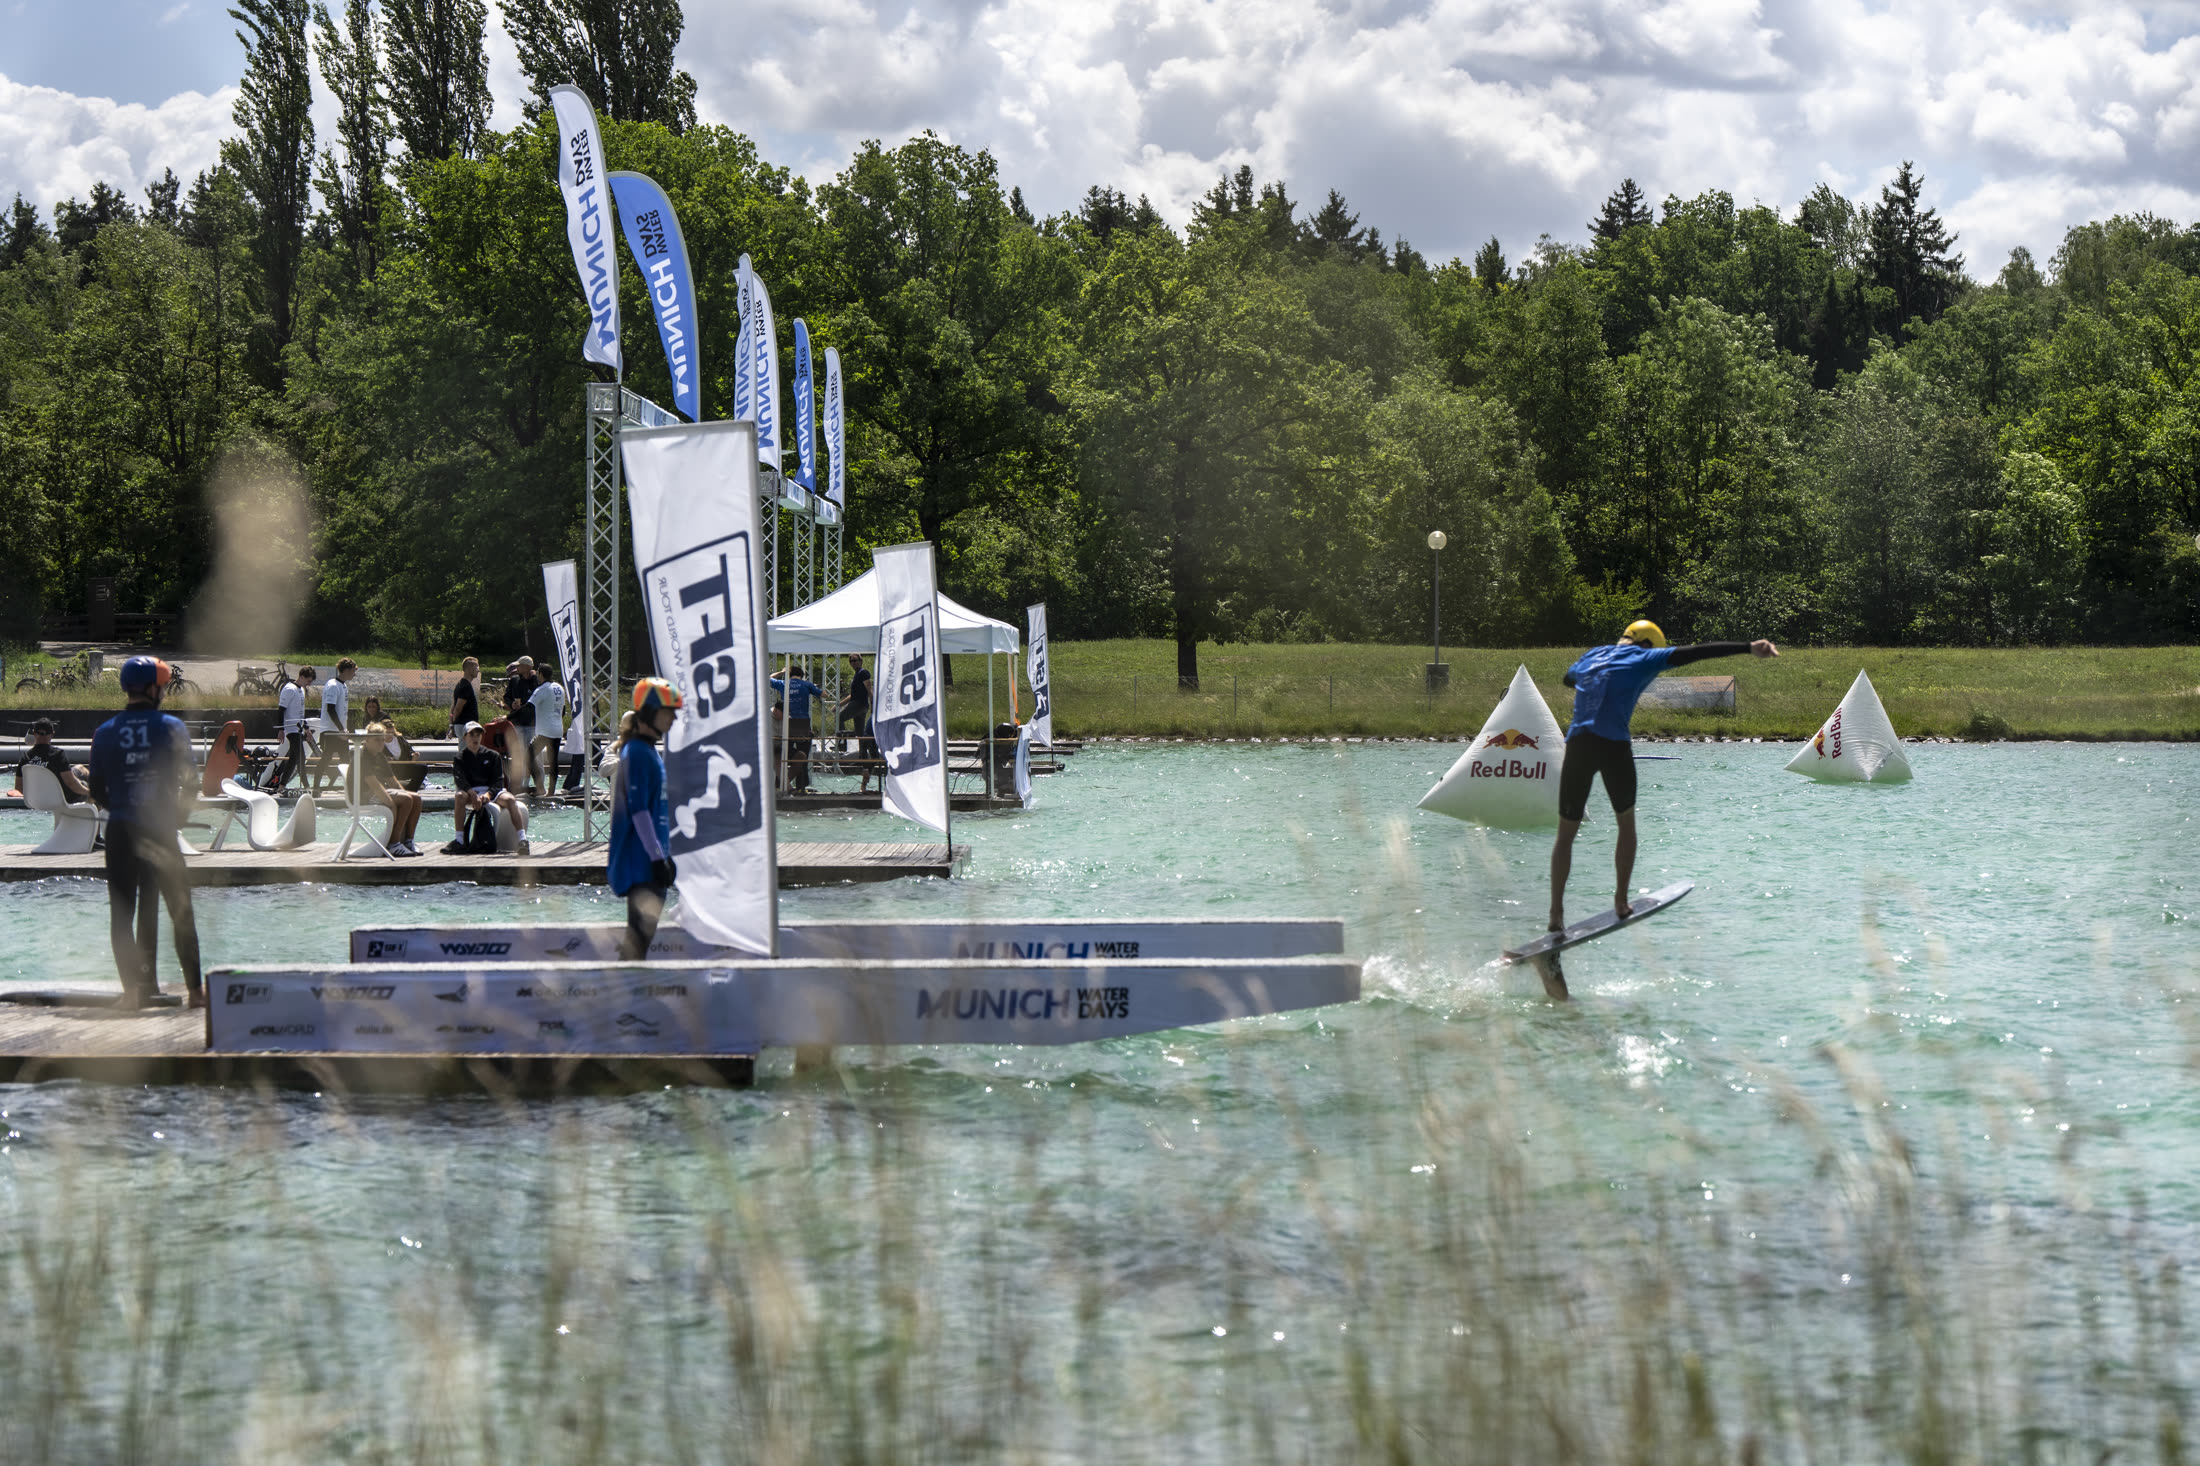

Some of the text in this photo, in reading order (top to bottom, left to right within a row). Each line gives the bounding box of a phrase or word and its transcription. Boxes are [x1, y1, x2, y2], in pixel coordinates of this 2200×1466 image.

[119, 726, 151, 749] 31
[1830, 707, 1842, 759] Red Bull
[1470, 759, 1547, 780] Red Bull
[957, 942, 1090, 959] MUNICH
[1094, 942, 1139, 954] WATER
[1077, 987, 1129, 1001] WATER
[916, 988, 1070, 1020] MUNICH
[1078, 1003, 1129, 1019] DAYS
